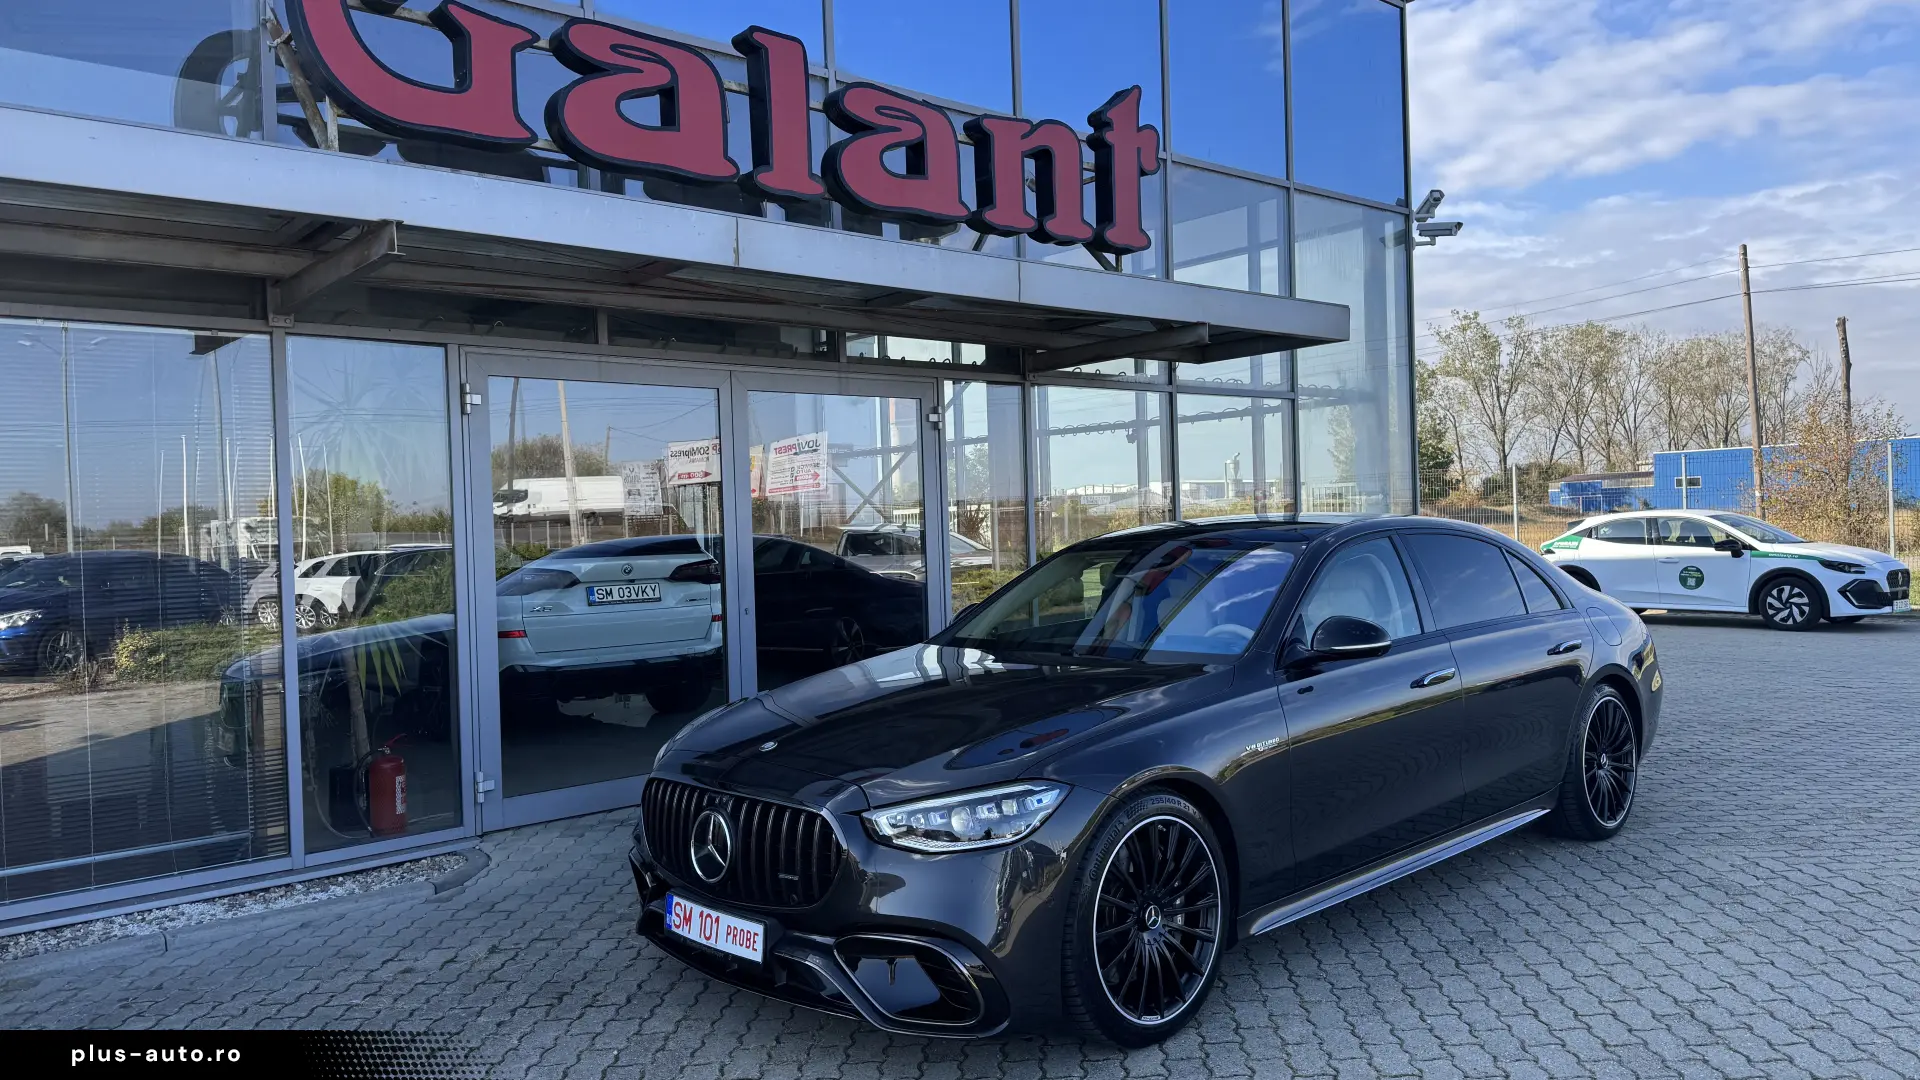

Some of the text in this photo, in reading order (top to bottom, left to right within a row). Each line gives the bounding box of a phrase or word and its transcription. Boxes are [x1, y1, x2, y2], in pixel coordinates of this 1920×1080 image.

[284, 0, 1160, 255] Galant
[596, 588, 614, 600] SM
[617, 585, 657, 599] 03VKY
[1150, 796, 1177, 806] 255/40
[673, 901, 693, 934] SM
[698, 910, 721, 945] 101
[725, 924, 759, 952] PROBE
